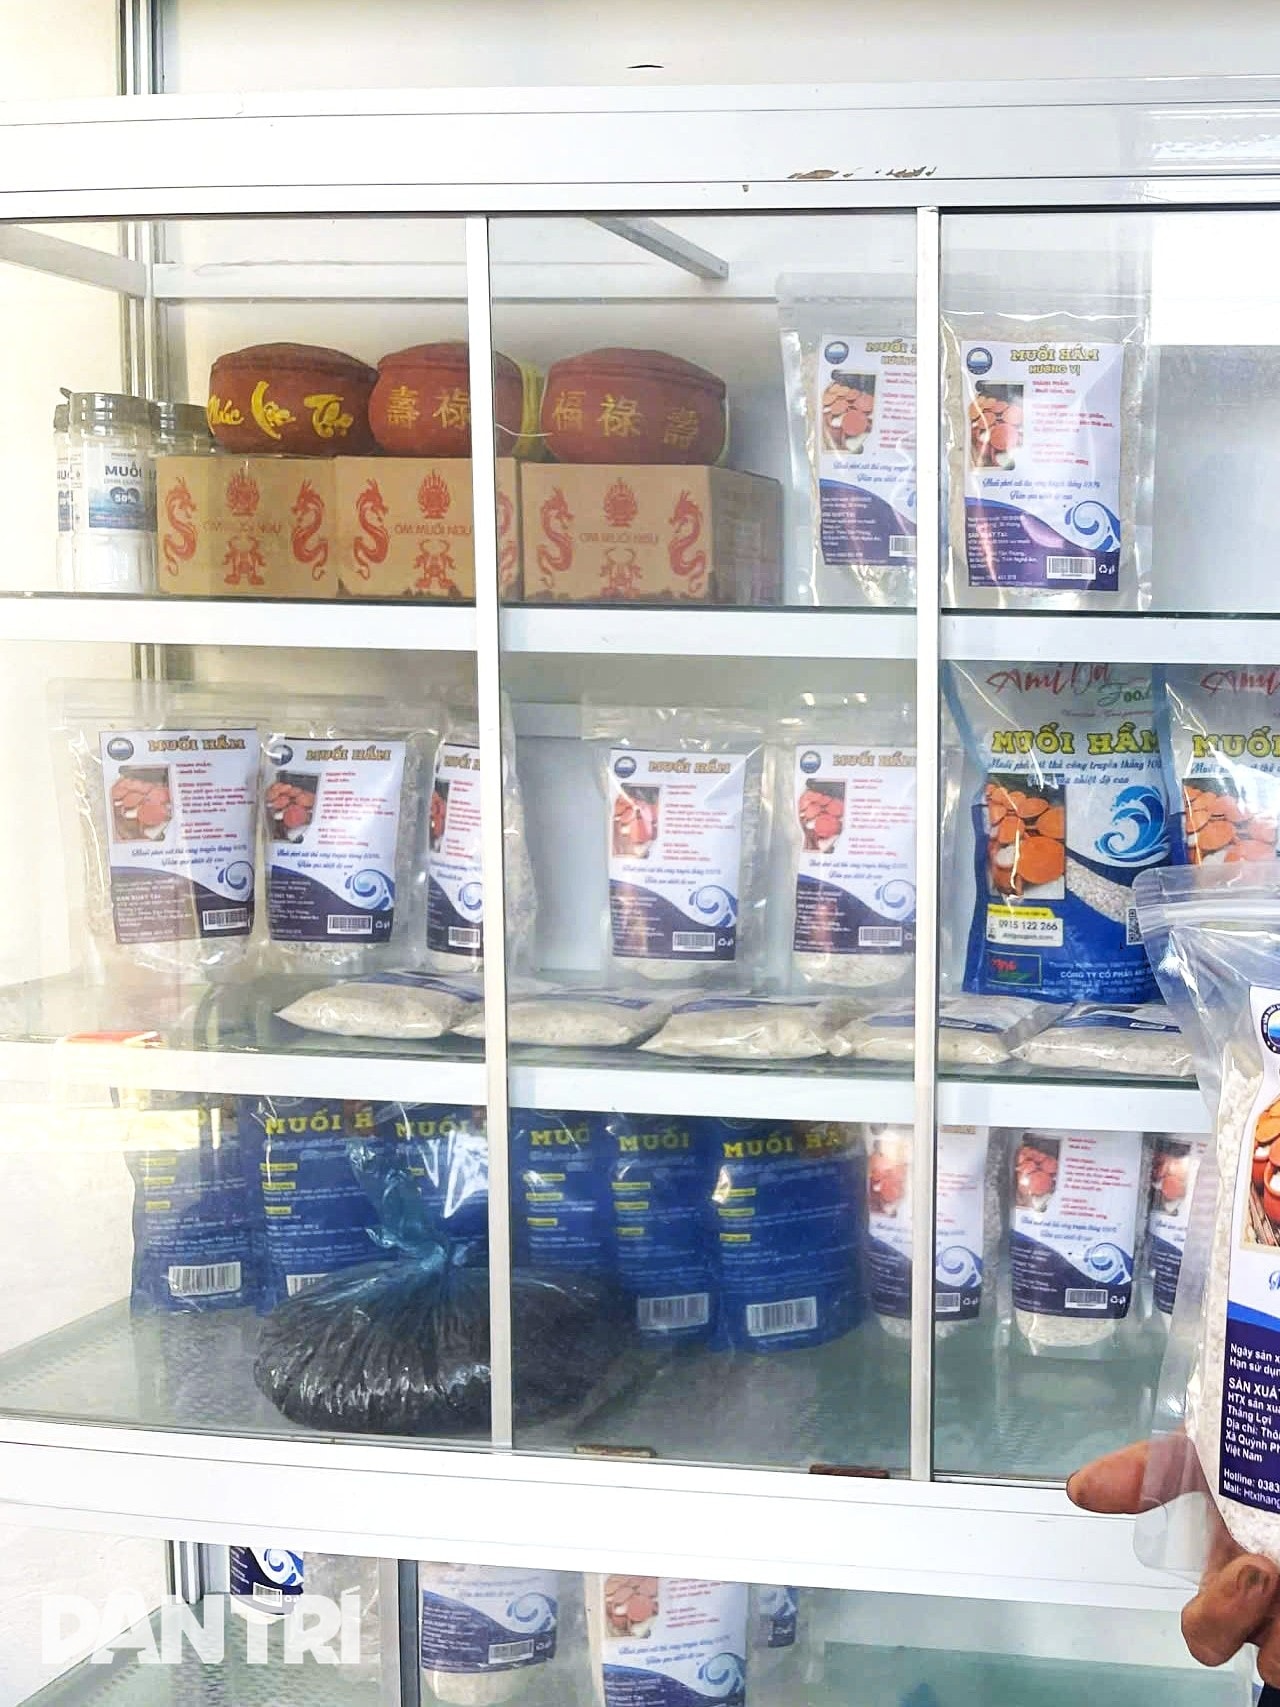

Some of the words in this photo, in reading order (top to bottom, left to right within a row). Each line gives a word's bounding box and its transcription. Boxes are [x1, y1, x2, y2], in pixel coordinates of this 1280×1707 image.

[991, 722, 1075, 754] MUỐI
[1022, 921, 1037, 930] 122
[1040, 922, 1059, 931] 266
[265, 1108, 342, 1135] MUỐI
[1230, 1343, 1253, 1360] Ngày
[1255, 1349, 1272, 1363] sản
[1229, 1356, 1247, 1371] Hạn
[1228, 1377, 1251, 1394] SẢN
[1227, 1391, 1246, 1406] HTX
[1248, 1397, 1264, 1410] sản
[1226, 1417, 1240, 1431] Địa
[1255, 1412, 1272, 1427] Lợi
[1224, 1443, 1241, 1459] Việt
[1242, 1450, 1263, 1463] Nam
[1223, 1468, 1255, 1487] Hotline:
[1257, 1479, 1280, 1494] 0383
[1223, 1480, 1241, 1495] Mail:
